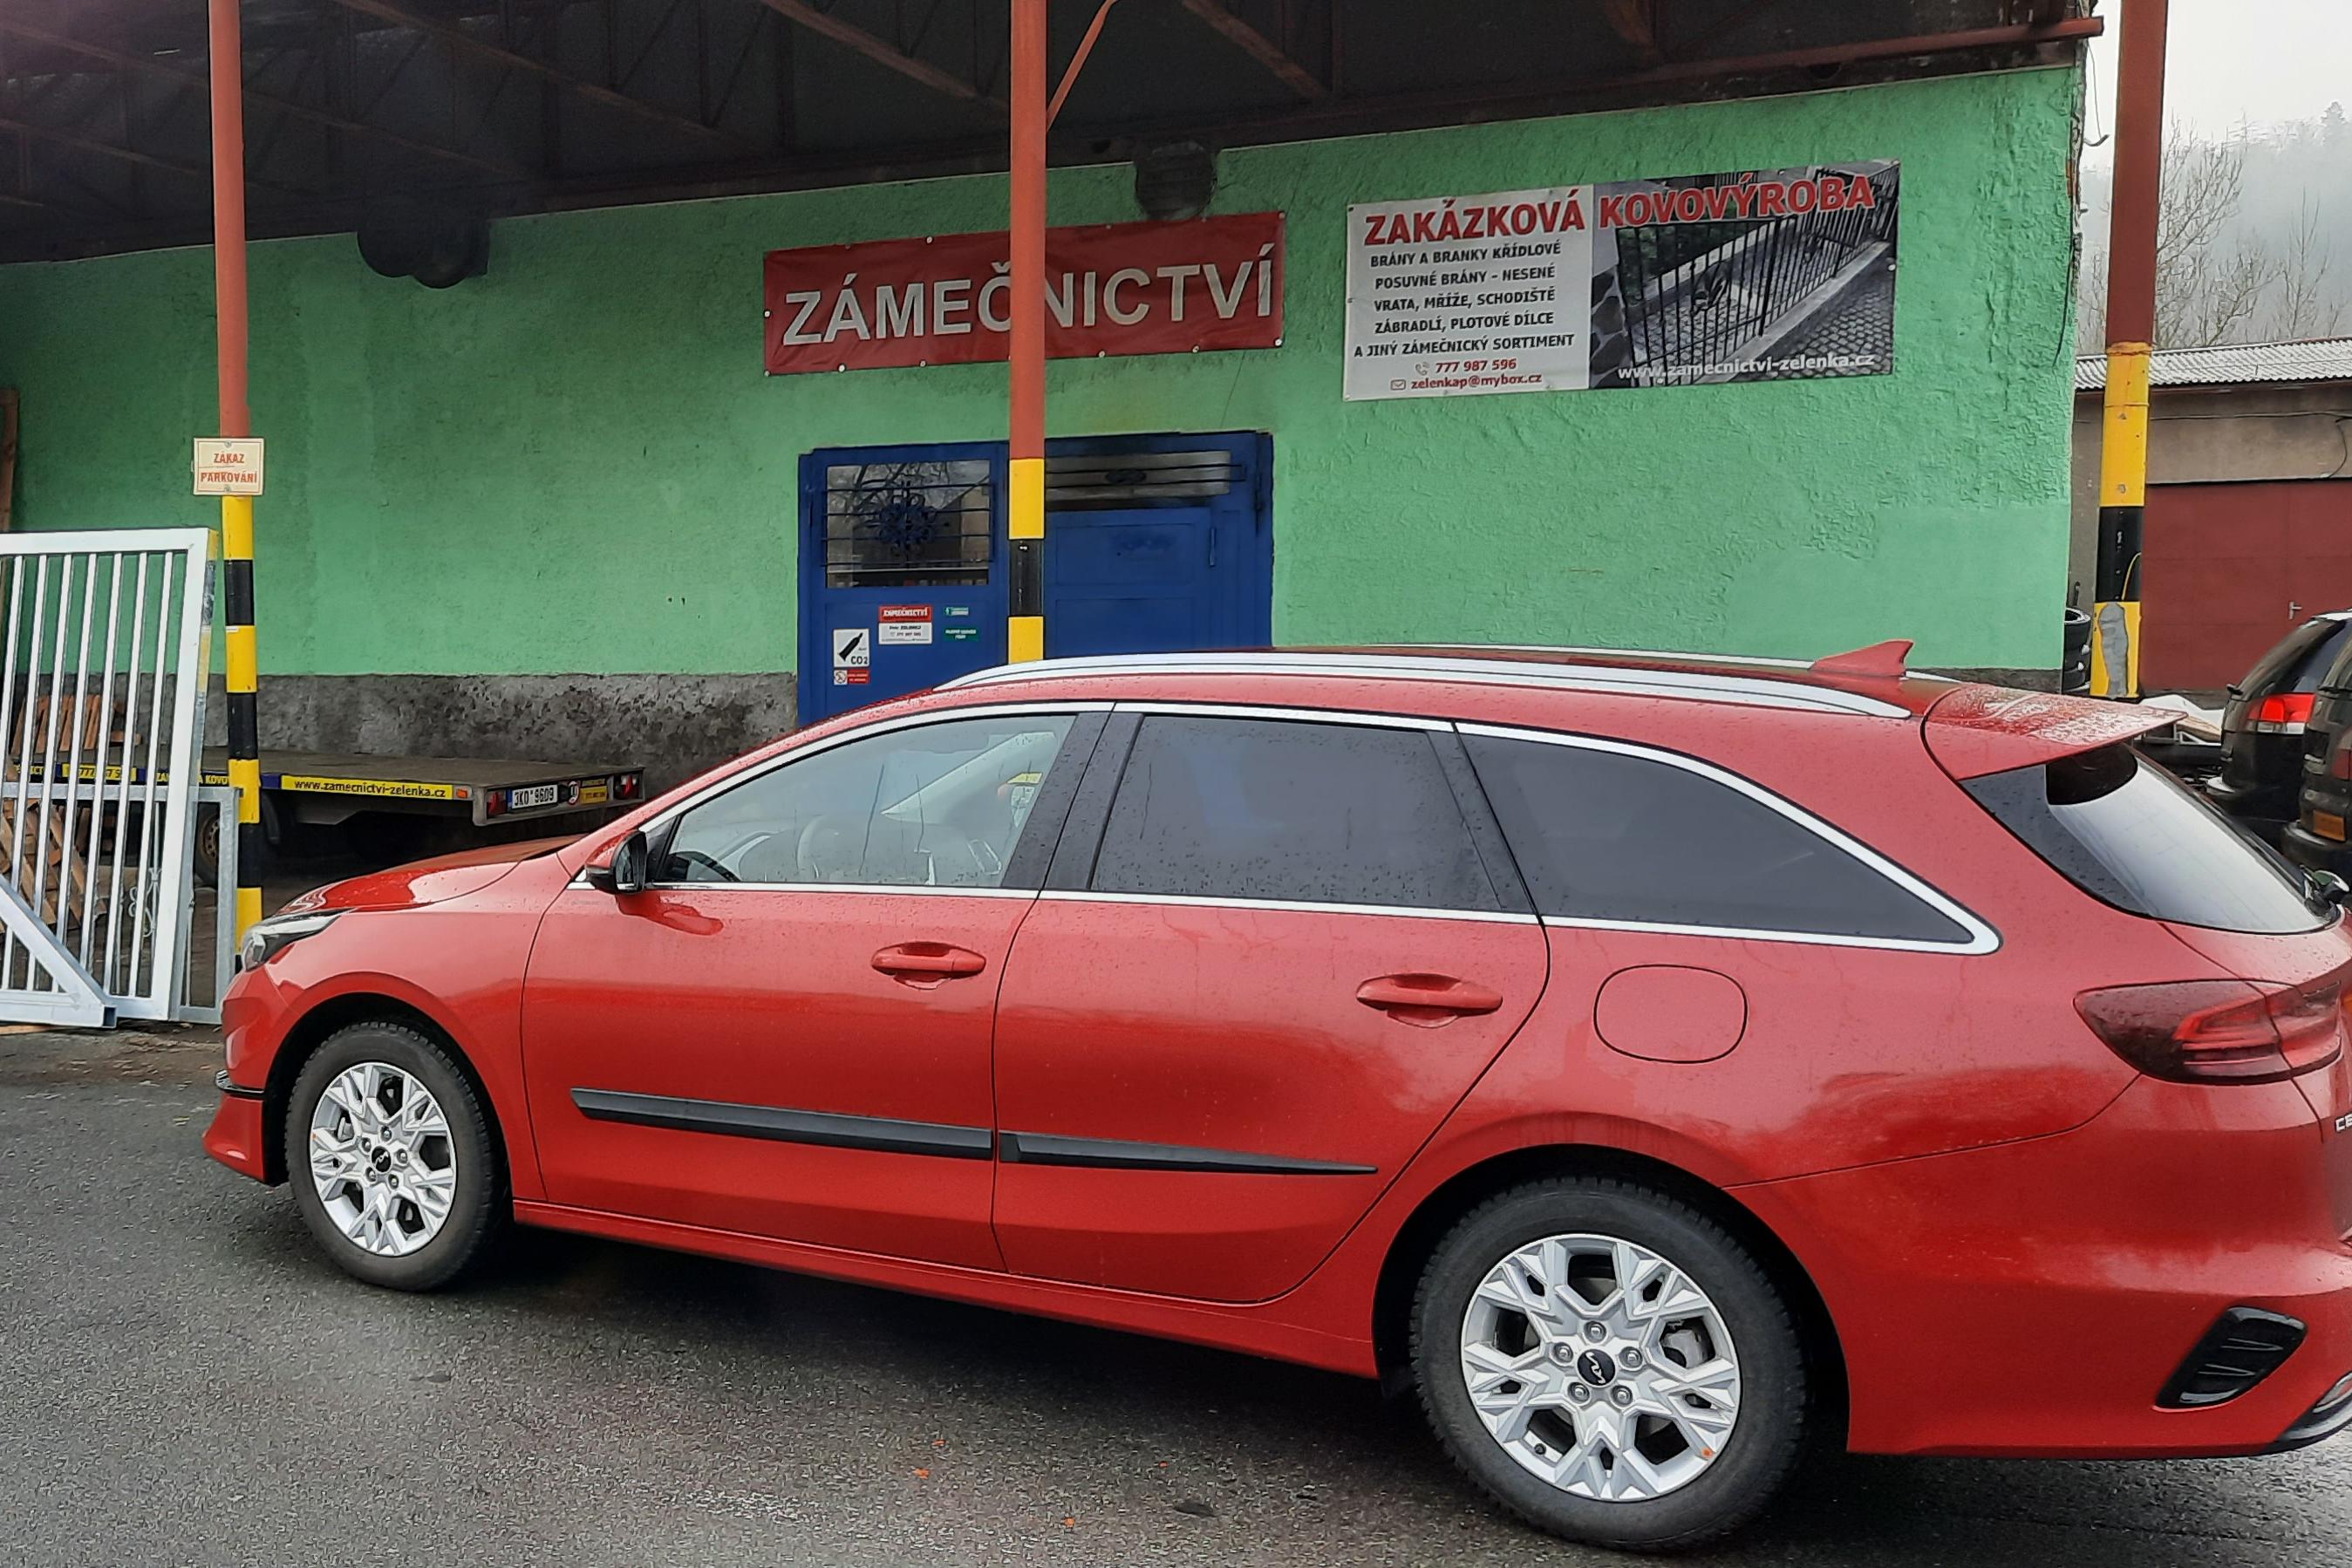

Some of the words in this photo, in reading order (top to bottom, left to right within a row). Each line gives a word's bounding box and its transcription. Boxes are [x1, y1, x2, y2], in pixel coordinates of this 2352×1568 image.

[1364, 188, 1585, 246] ZAKÁZKOVÁ
[1599, 173, 1875, 228] KOVOVÝROBA
[1370, 252, 1416, 268] BRÁNY
[1419, 252, 1428, 264] A
[1433, 249, 1489, 263] BRANKY
[1492, 239, 1561, 259] KŘÍDLOVÉ
[1375, 270, 1436, 290] POSUVNÉ
[1442, 269, 1487, 286] BRÁNY
[1502, 262, 1556, 281] NESENÉ
[1374, 298, 1420, 312] VRATA,
[1424, 291, 1473, 309] MŘÍŽE,
[1374, 315, 1446, 334] ZÁBRADLÍ,
[1450, 310, 1510, 330] PLOTOVÉ
[1514, 310, 1554, 326] DÍLCE
[1353, 348, 1363, 358] A
[1367, 341, 1398, 357] JINÝ
[1401, 335, 1489, 355] ZÁMEČNICKÝ
[1492, 333, 1575, 350] SORTIMENT
[1435, 361, 1460, 374] 777
[1463, 359, 1488, 372] 987
[1492, 358, 1517, 370] 596
[1618, 354, 1875, 378] www.zamecnictvi-zelenka.cz
[1410, 373, 1542, 390] zelenkap@mybox.cz
[294, 781, 446, 798] www.zamecnictvi-zelenka.cz
